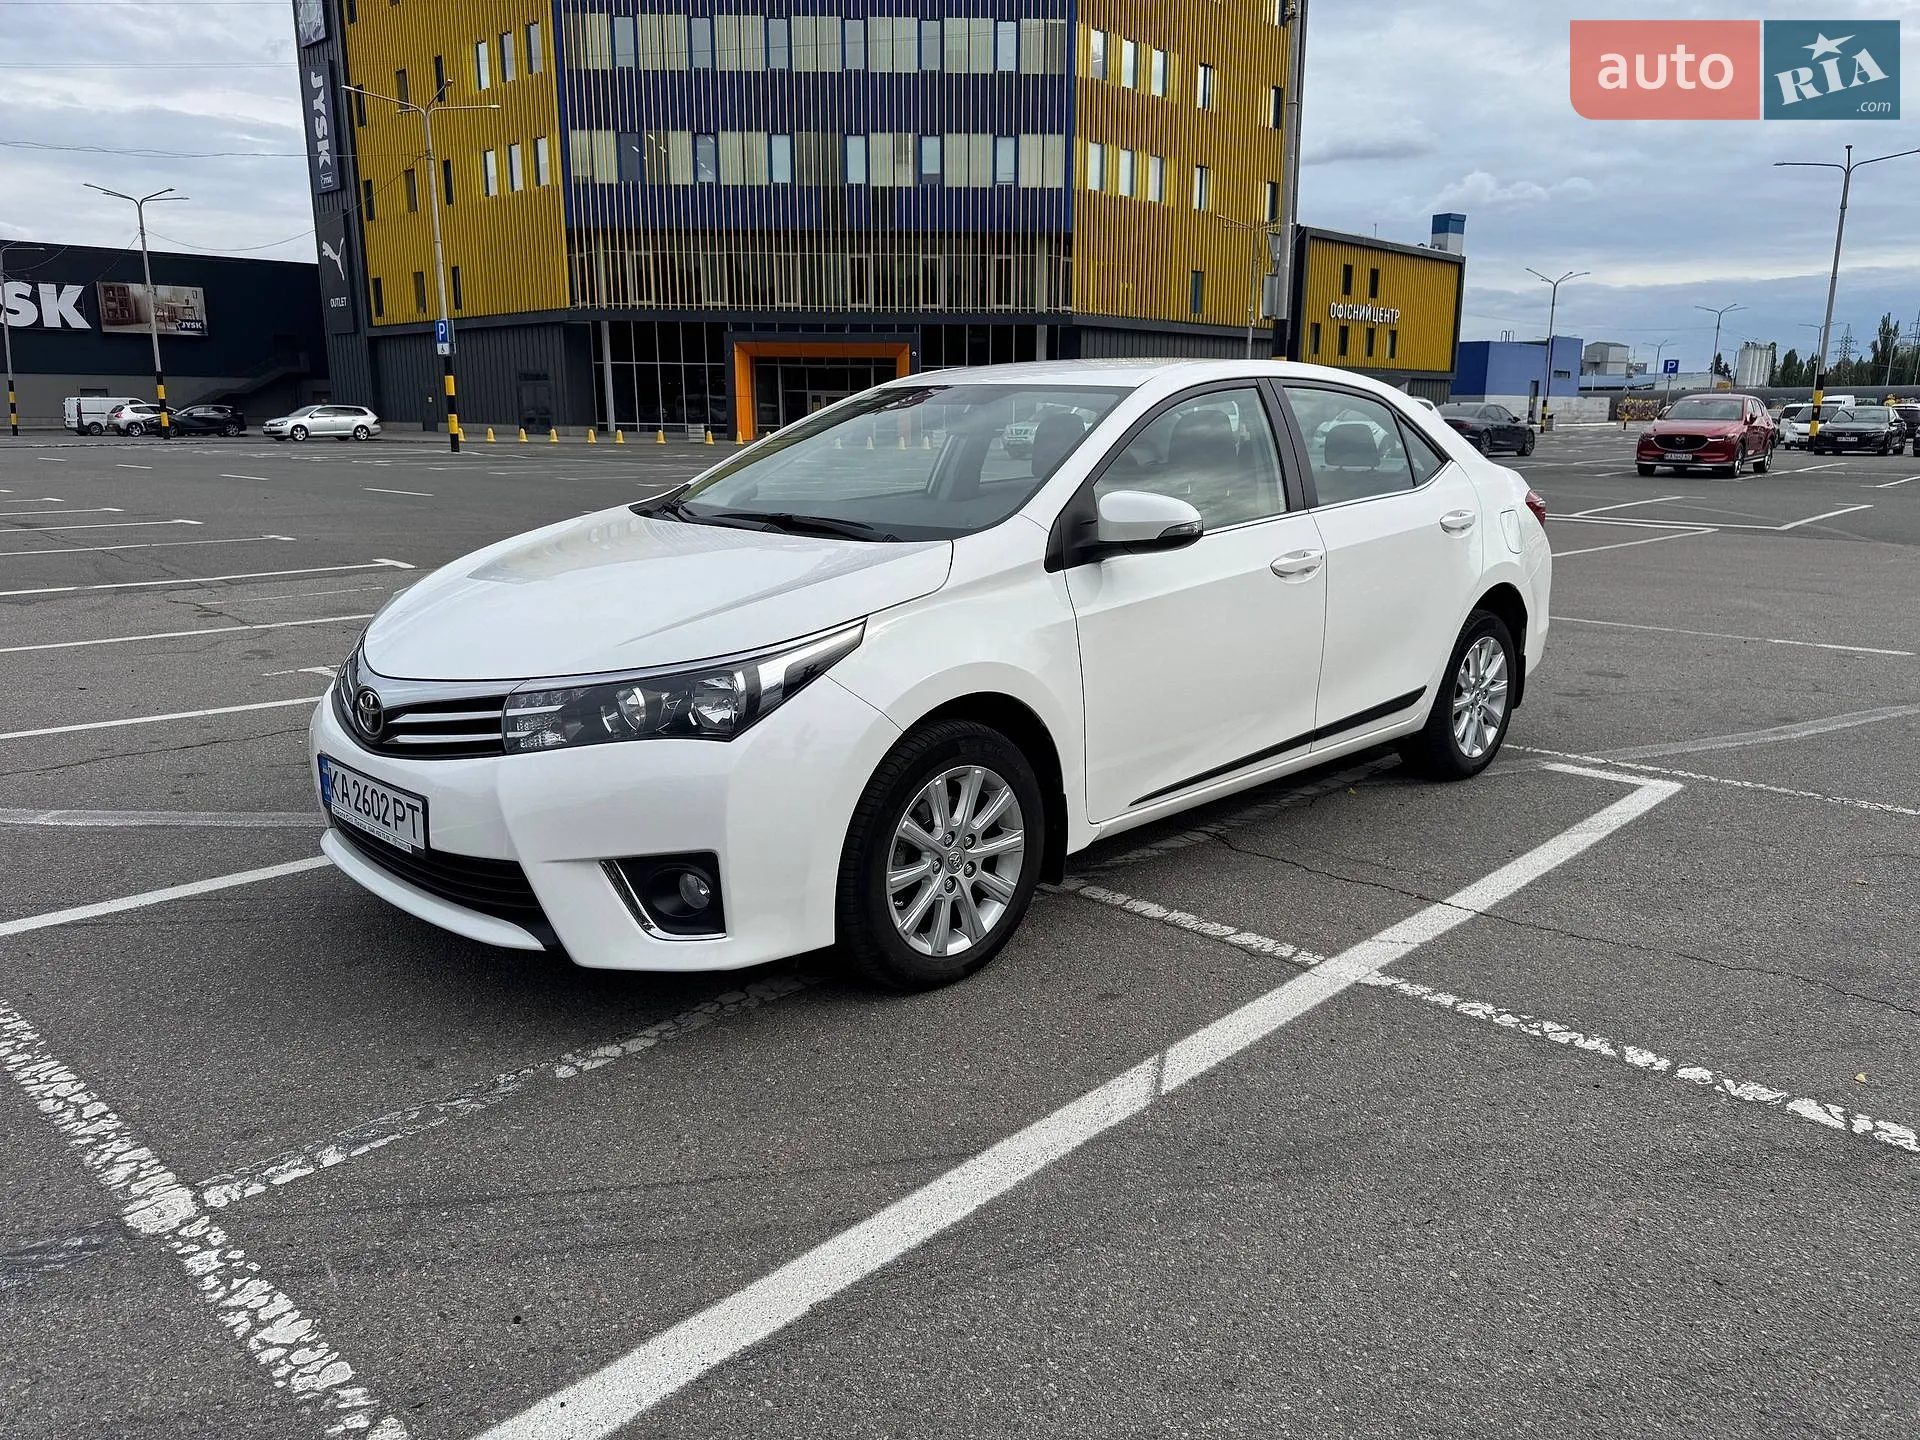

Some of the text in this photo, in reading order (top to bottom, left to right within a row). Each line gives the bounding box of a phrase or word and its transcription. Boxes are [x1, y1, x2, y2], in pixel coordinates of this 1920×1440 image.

[311, 71, 331, 169] JYSK
[0, 281, 92, 329] SK
[330, 297, 347, 308] OUTLET
[1330, 302, 1400, 326] ОФІСНИЙ ЦЕНТР
[181, 321, 203, 330] JYSK
[438, 322, 446, 341] P
[1667, 360, 1676, 372] P
[328, 767, 352, 808] KA
[353, 779, 391, 828] 2602
[392, 796, 420, 840] PT
